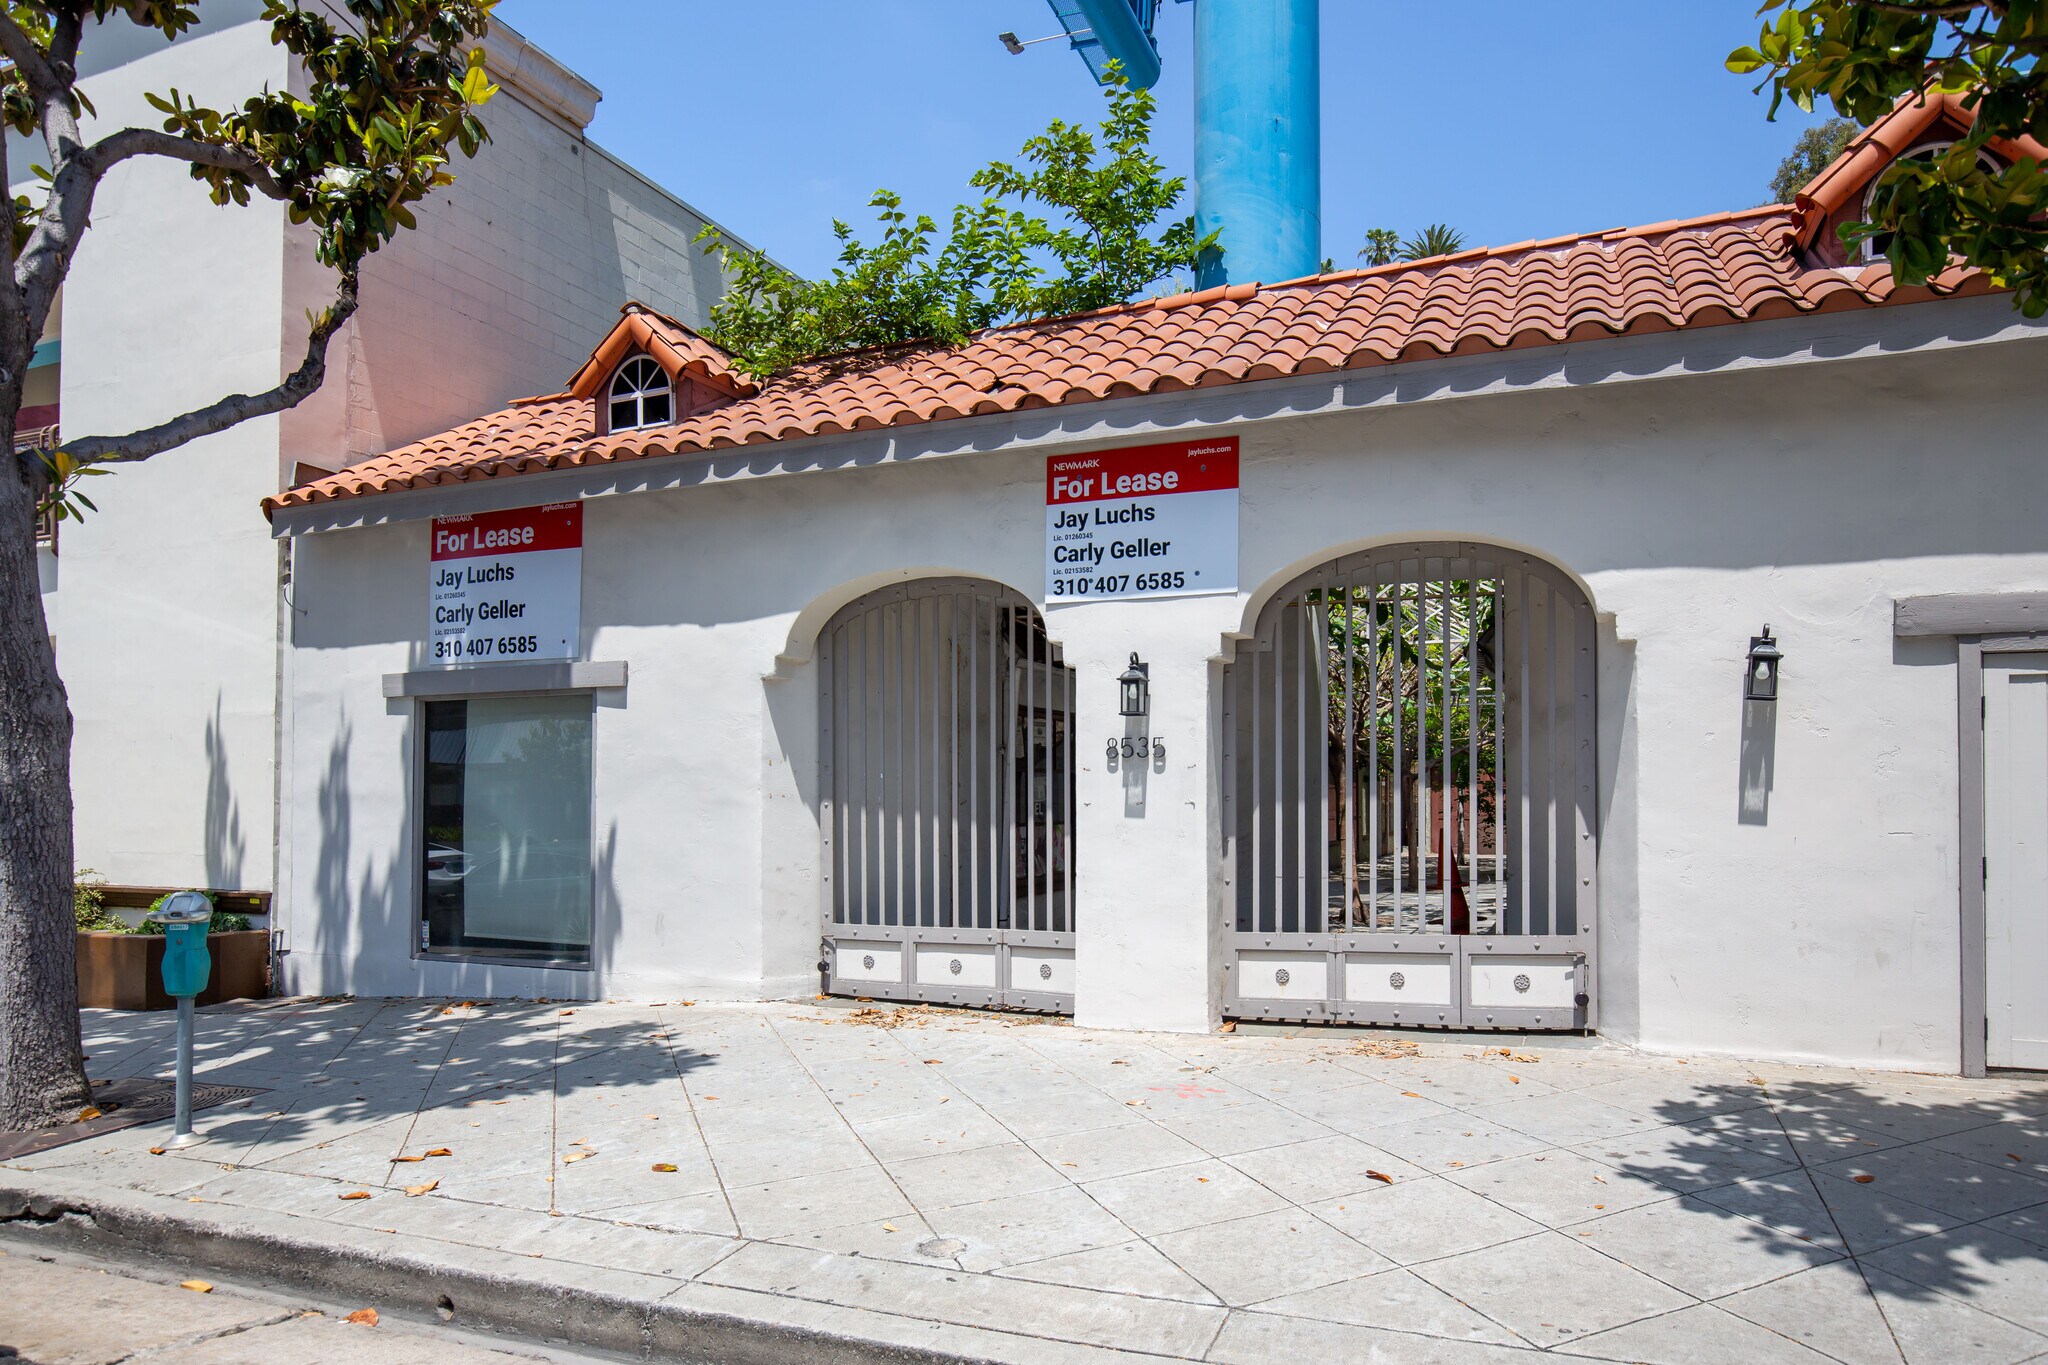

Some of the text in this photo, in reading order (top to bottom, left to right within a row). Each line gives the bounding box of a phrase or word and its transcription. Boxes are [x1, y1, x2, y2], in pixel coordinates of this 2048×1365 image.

[1187, 445, 1232, 457] jayluchs.com
[1053, 458, 1100, 472] NEWMARK
[1053, 470, 1179, 500] For Lease
[541, 502, 577, 513] jayluchs.com
[1054, 503, 1156, 531] Jay Luchs
[437, 514, 474, 525] NEWMARK
[436, 525, 535, 554] For Lease
[1064, 532, 1093, 541] 01260345
[1053, 538, 1171, 566] Carly Geller
[436, 562, 515, 590] Jay Luchs
[1064, 566, 1093, 574] 02153582
[1053, 571, 1185, 596] 310 407 6585
[435, 599, 526, 626] Carly Geller
[435, 635, 538, 658] 310 407 6585
[1106, 736, 1166, 759] 8535
